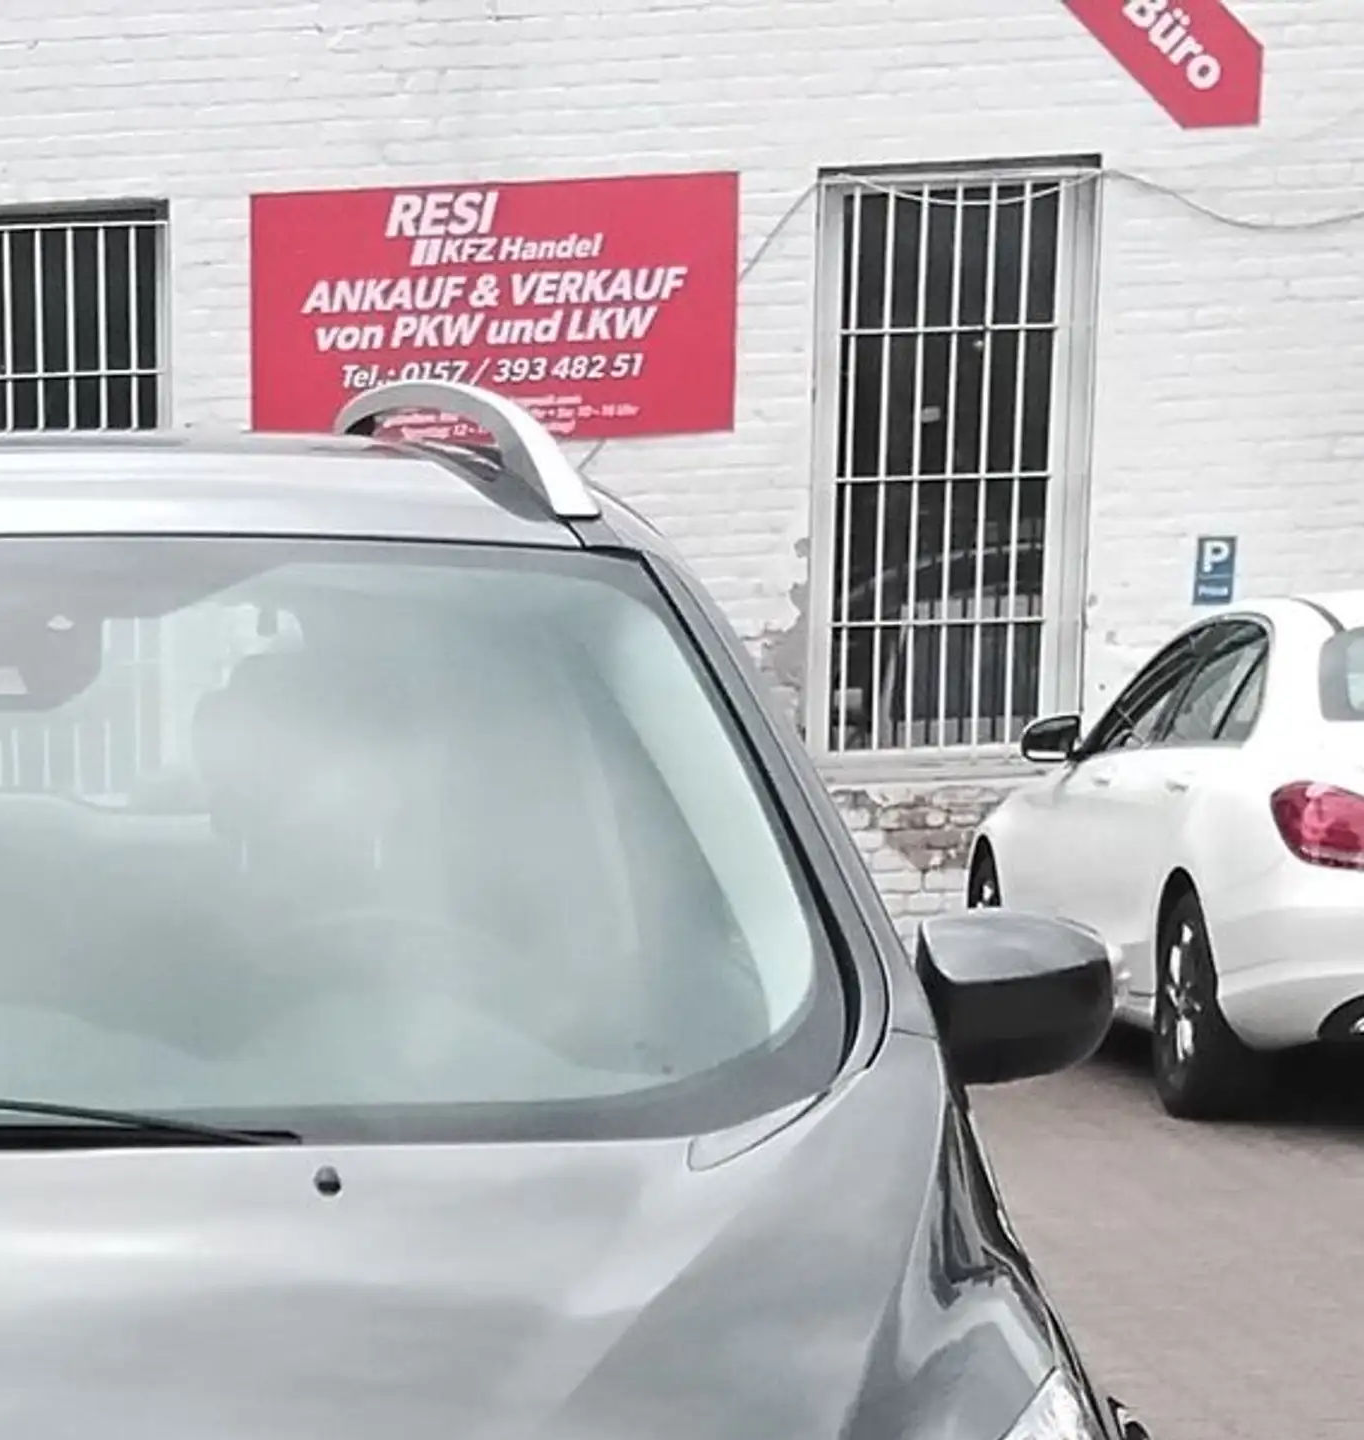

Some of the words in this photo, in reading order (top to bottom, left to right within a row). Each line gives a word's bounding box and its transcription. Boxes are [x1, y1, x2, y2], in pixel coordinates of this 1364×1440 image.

[1122, 0, 1222, 90] Büro
[384, 192, 499, 238] RESI
[441, 237, 498, 264] KFZ
[498, 232, 604, 262] Handel
[301, 275, 468, 314] ANKAUF
[469, 273, 501, 308] &
[511, 266, 689, 306] VERKAUF
[315, 325, 385, 352] von
[390, 313, 486, 349] PKW
[486, 309, 564, 345] und
[566, 306, 658, 342] LKW
[492, 357, 548, 384] 393
[551, 354, 607, 379] 482
[610, 353, 644, 379] 51
[1203, 541, 1229, 573] P
